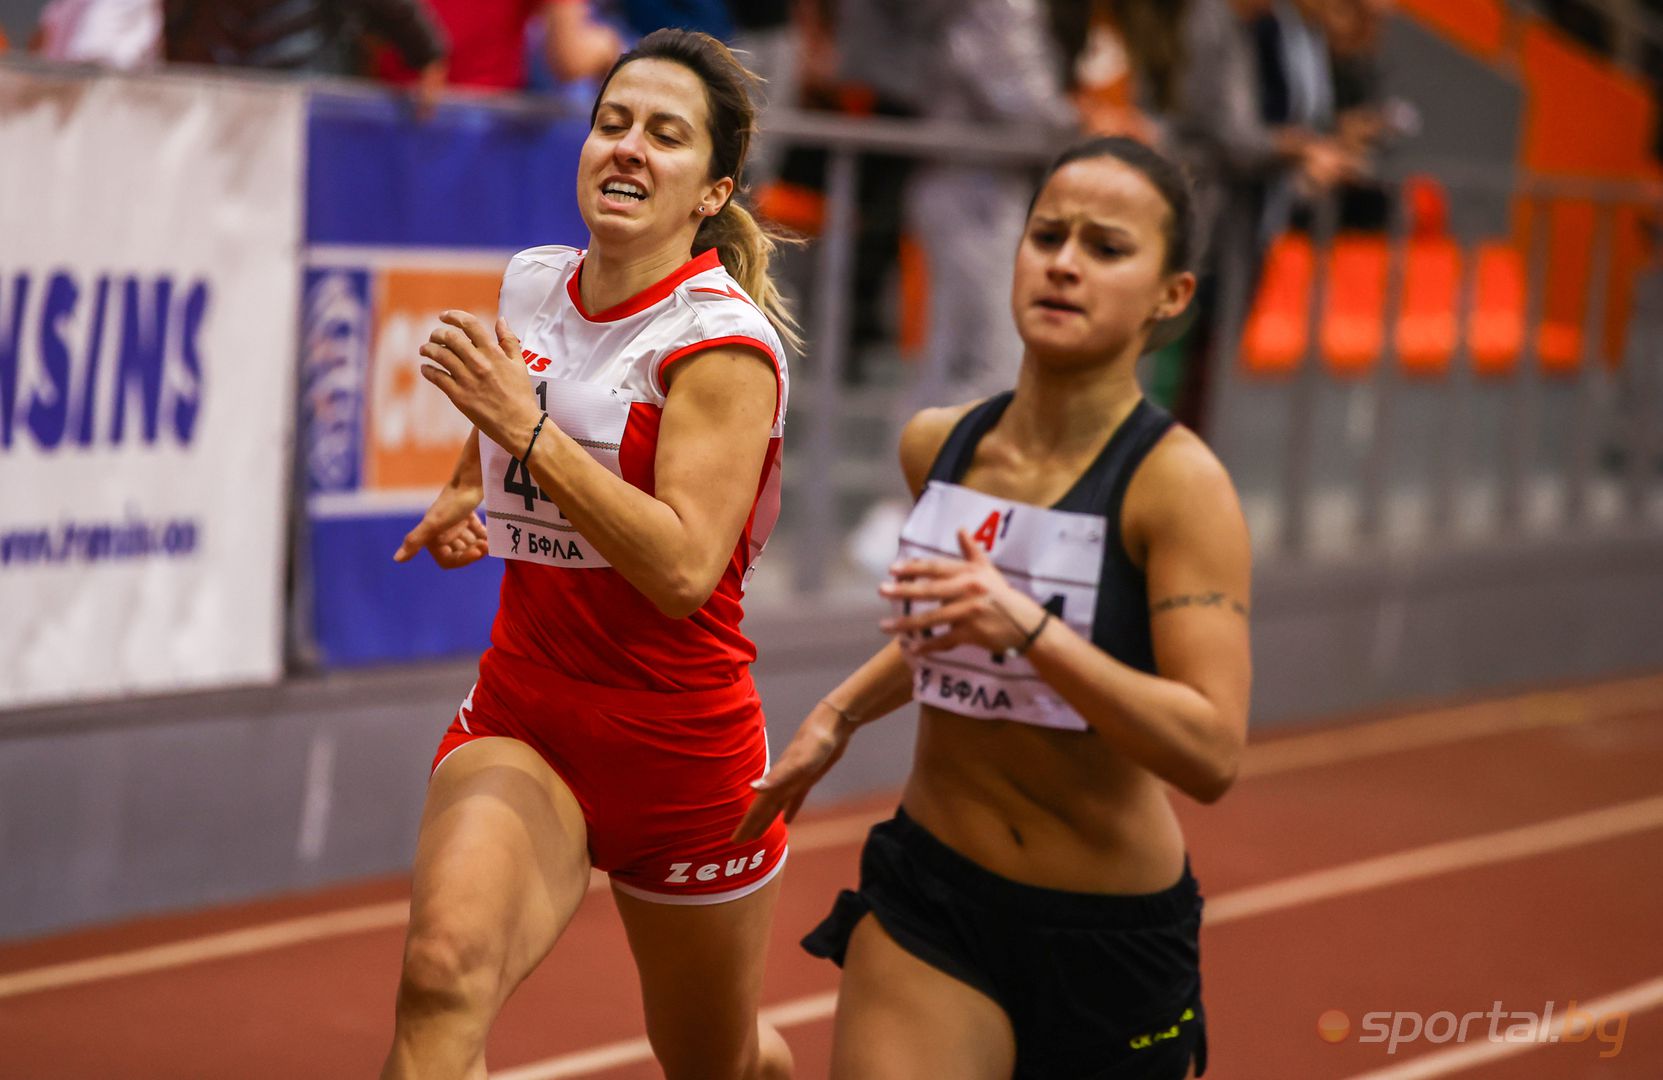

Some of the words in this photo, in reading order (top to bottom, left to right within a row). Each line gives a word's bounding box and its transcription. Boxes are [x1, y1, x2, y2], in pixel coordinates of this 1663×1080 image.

[528, 532, 584, 560] БФЛА
[974, 508, 1014, 552] A1
[940, 673, 1013, 711] БФЛА
